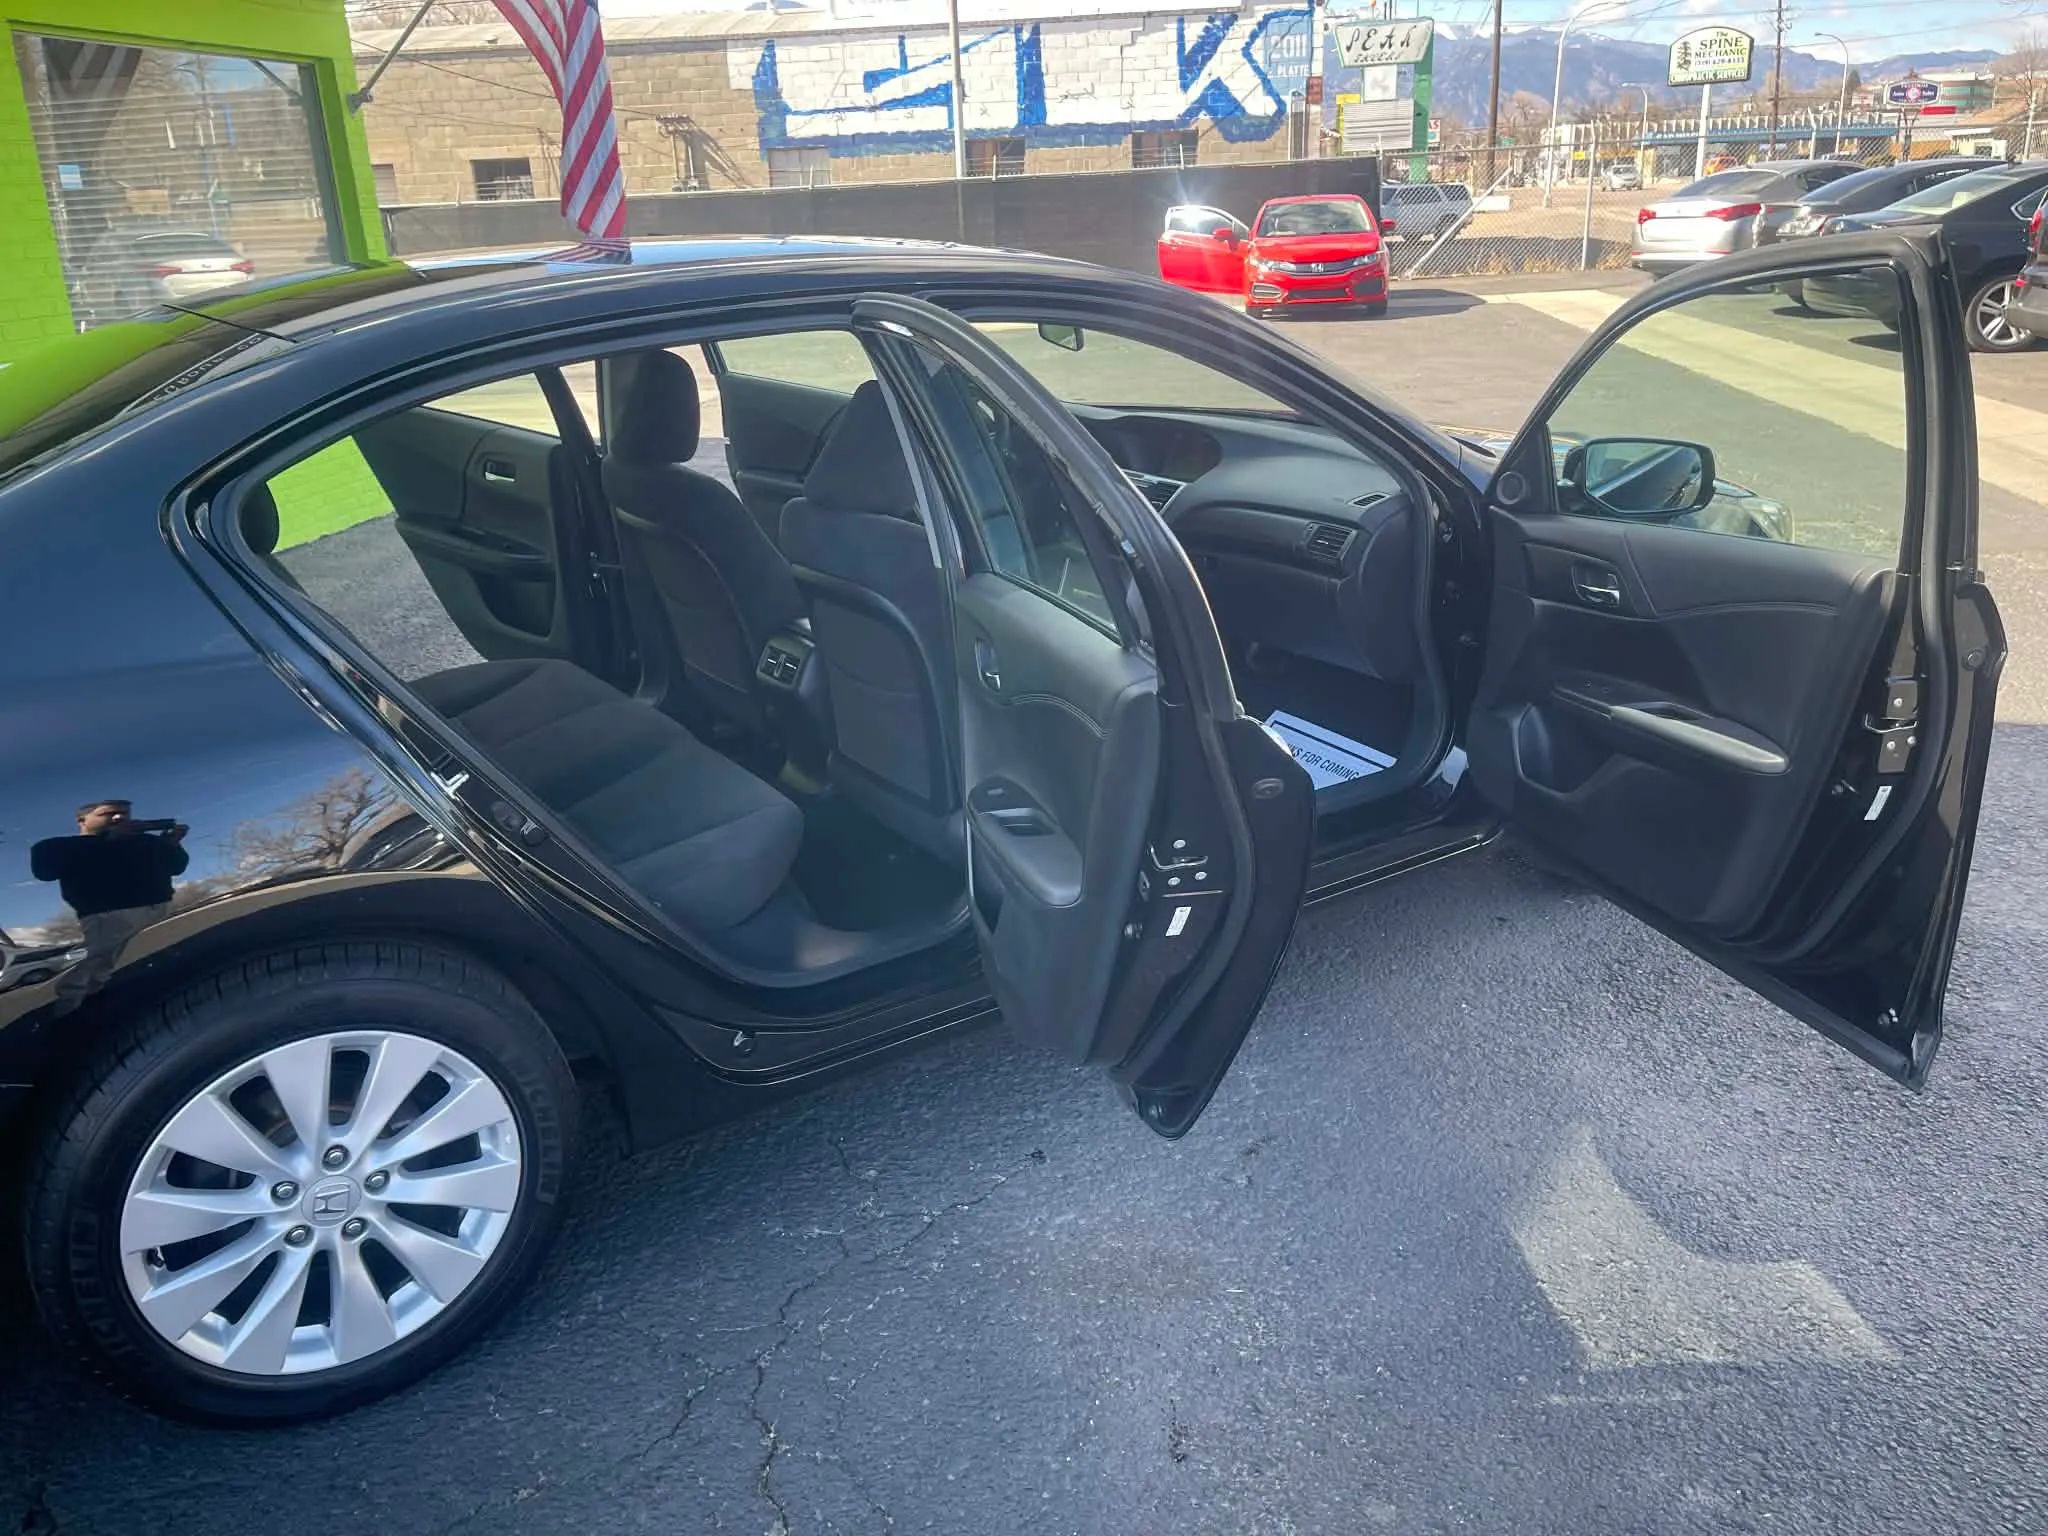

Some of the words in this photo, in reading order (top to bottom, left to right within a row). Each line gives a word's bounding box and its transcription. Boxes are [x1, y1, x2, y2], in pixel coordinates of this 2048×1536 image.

[1270, 34, 1307, 58] 2011
[1699, 36, 1744, 50] SPINE
[1694, 47, 1747, 59] MECHANIC
[1277, 64, 1311, 77] PLATTE
[1300, 751, 1323, 767] FOR
[1319, 760, 1360, 781] COMING
